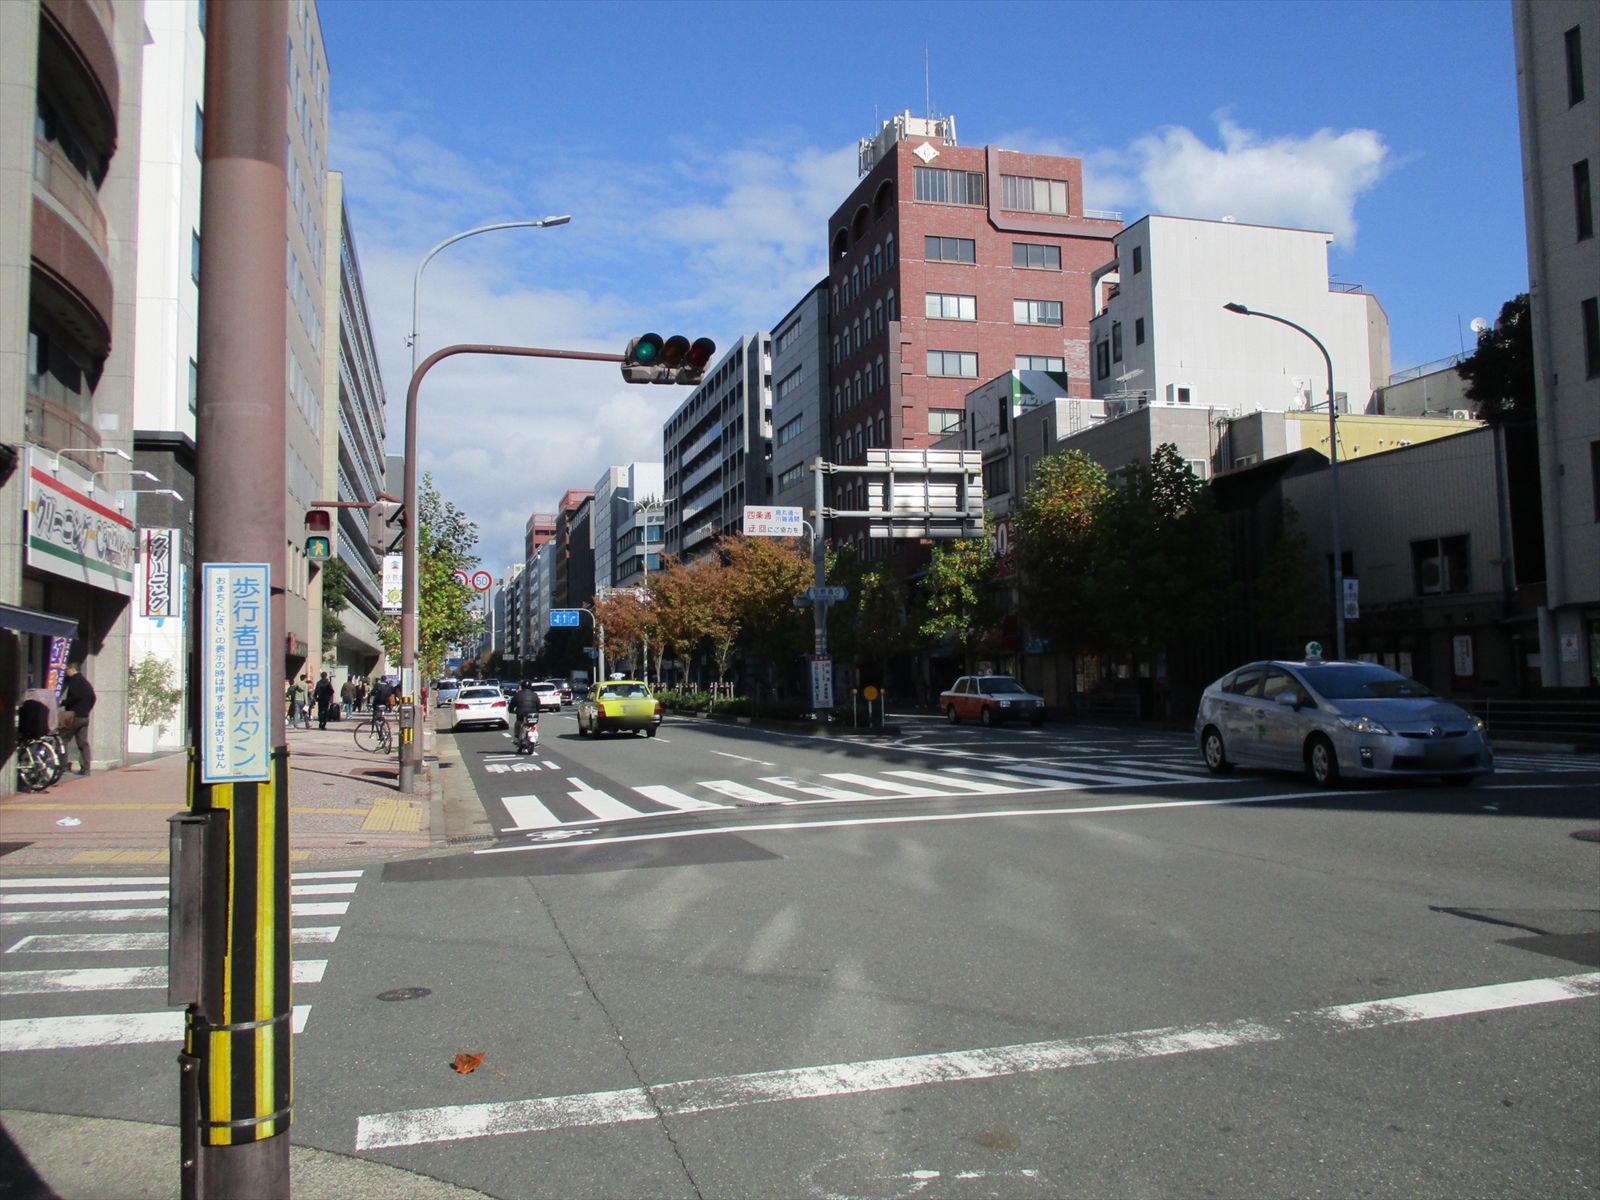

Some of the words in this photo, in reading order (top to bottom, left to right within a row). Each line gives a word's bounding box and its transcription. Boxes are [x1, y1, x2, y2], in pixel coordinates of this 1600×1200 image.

[36, 488, 91, 553] クリーニング
[149, 535, 170, 611] クリーニング
[475, 575, 488, 587] 50
[232, 576, 261, 767] 歩行者用押ボタン
